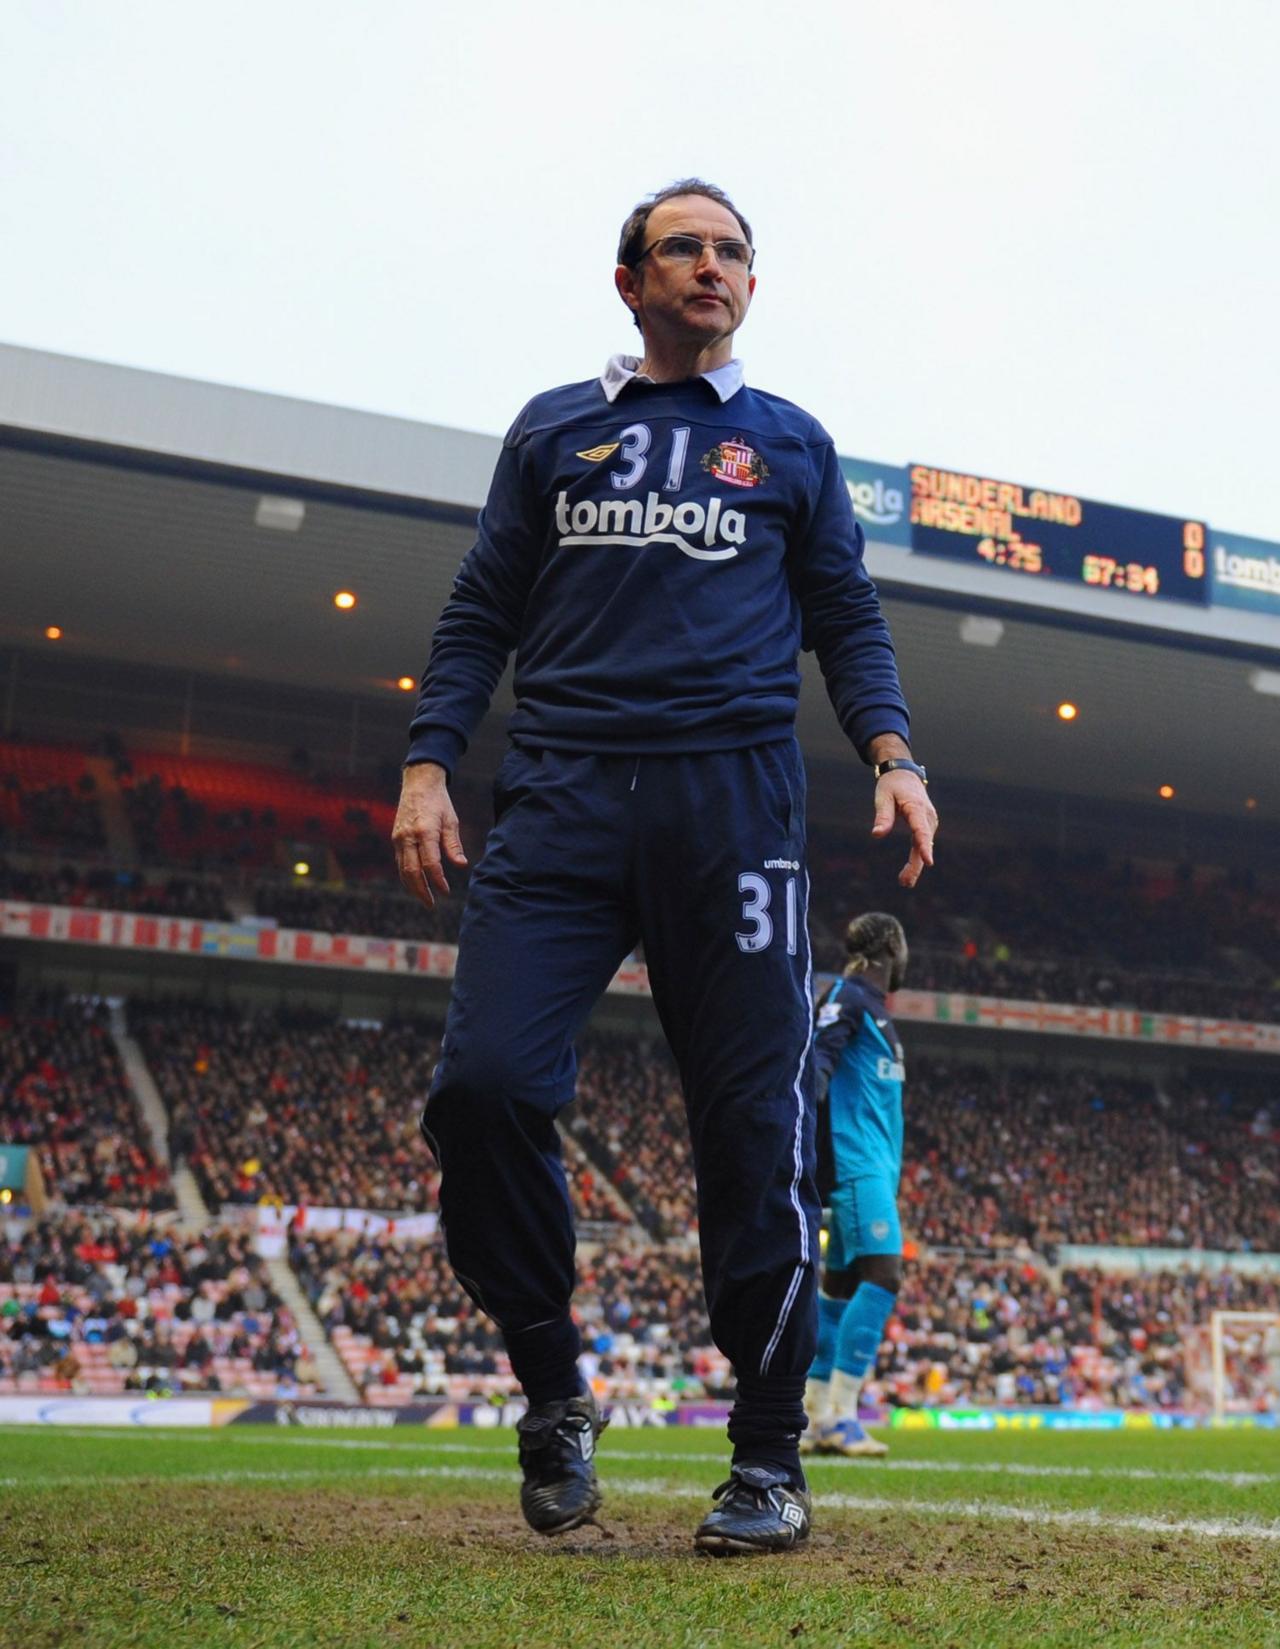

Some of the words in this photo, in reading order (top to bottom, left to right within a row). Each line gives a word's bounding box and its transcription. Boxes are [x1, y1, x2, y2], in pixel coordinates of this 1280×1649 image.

[611, 423, 691, 492] 31
[555, 491, 747, 547] tombola
[910, 498, 1021, 542] ARSENAL
[1183, 549, 1205, 578] 0
[911, 466, 1082, 527] SUNDERLAND
[1183, 522, 1204, 549] 0
[735, 872, 797, 956] 31
